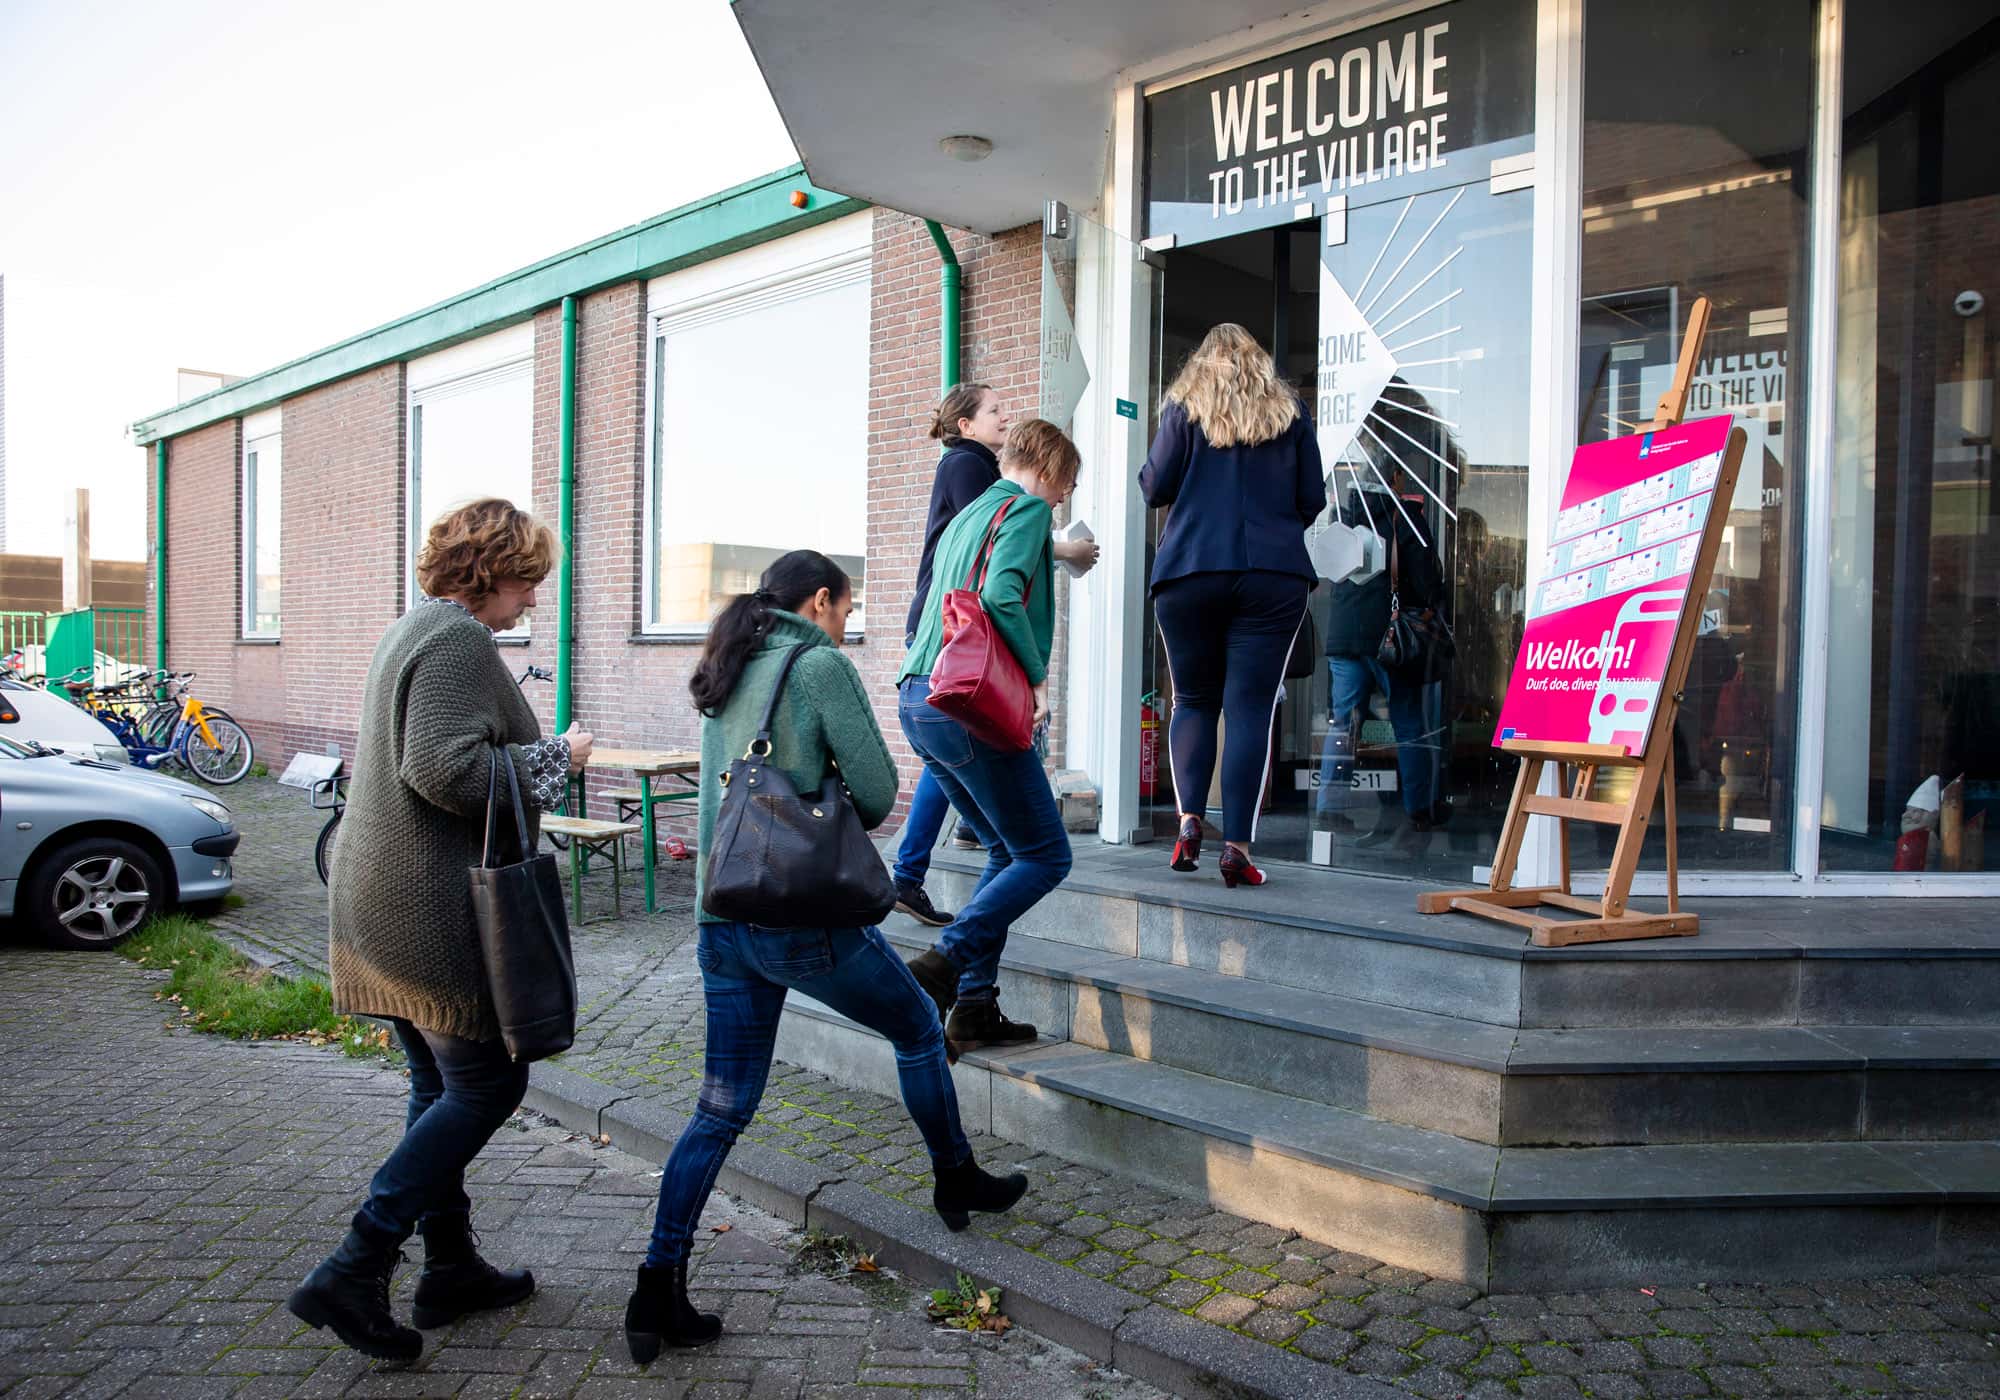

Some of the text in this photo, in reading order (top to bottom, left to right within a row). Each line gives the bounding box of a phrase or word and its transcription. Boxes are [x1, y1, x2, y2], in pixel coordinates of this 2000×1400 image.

[1210, 21, 1449, 163] WELCOME
[1208, 113, 1448, 220] TO THE VILLAGE
[1690, 382, 1712, 412] TO
[1719, 376, 1756, 408] THE
[1525, 638, 1637, 670] Welkom!
[1525, 677, 1549, 692] Durf,
[1549, 677, 1570, 692] doe,
[1571, 677, 1600, 691] divers
